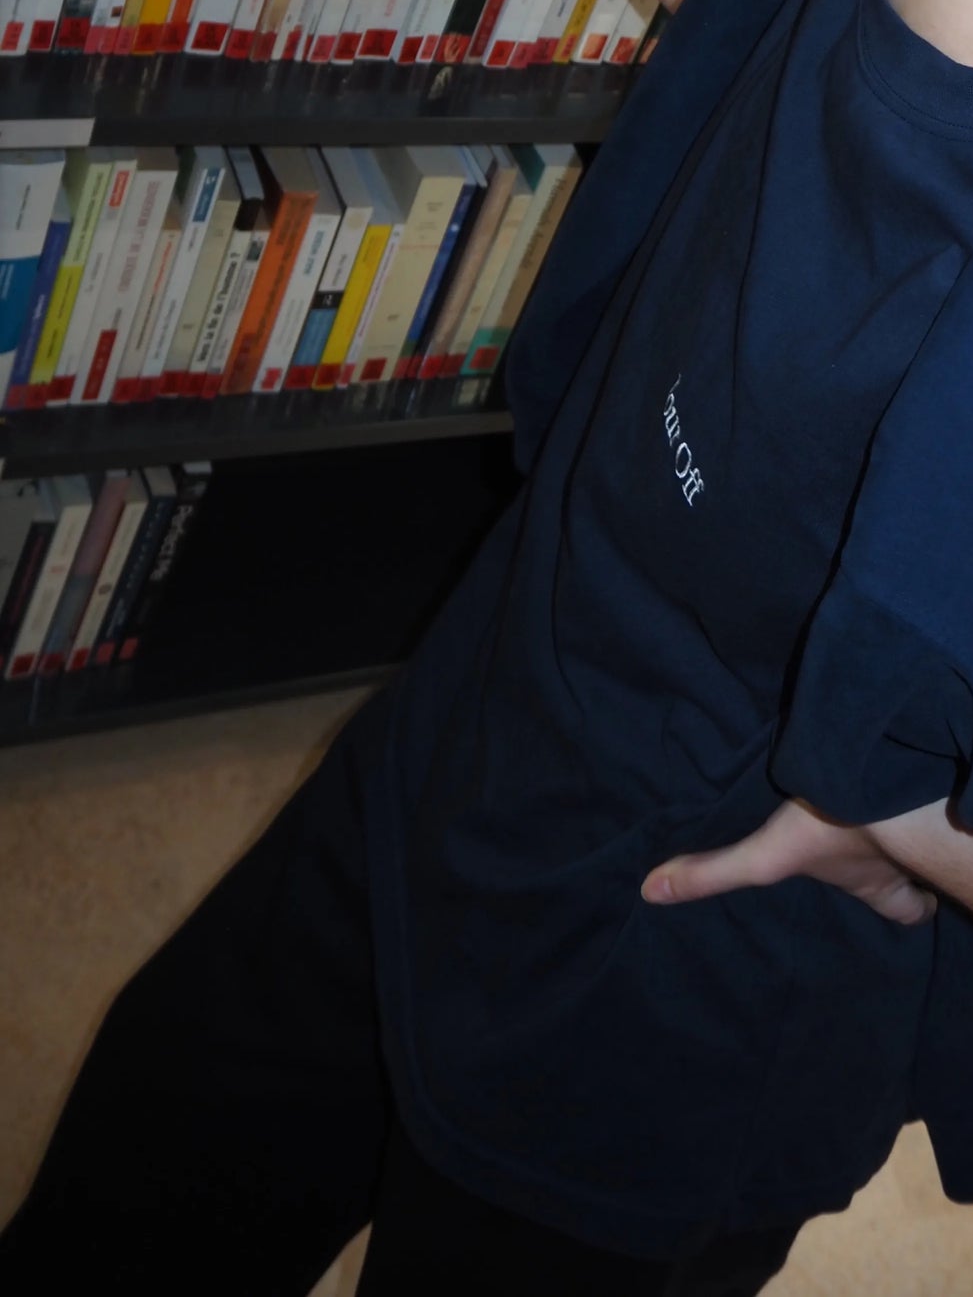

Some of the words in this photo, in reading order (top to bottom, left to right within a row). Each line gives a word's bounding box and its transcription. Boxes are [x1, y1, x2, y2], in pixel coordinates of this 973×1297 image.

[217, 259, 238, 300] l'homme
[213, 301, 224, 315] de
[207, 317, 218, 329] fin
[204, 330, 214, 340] la
[676, 442, 704, 506] Off
